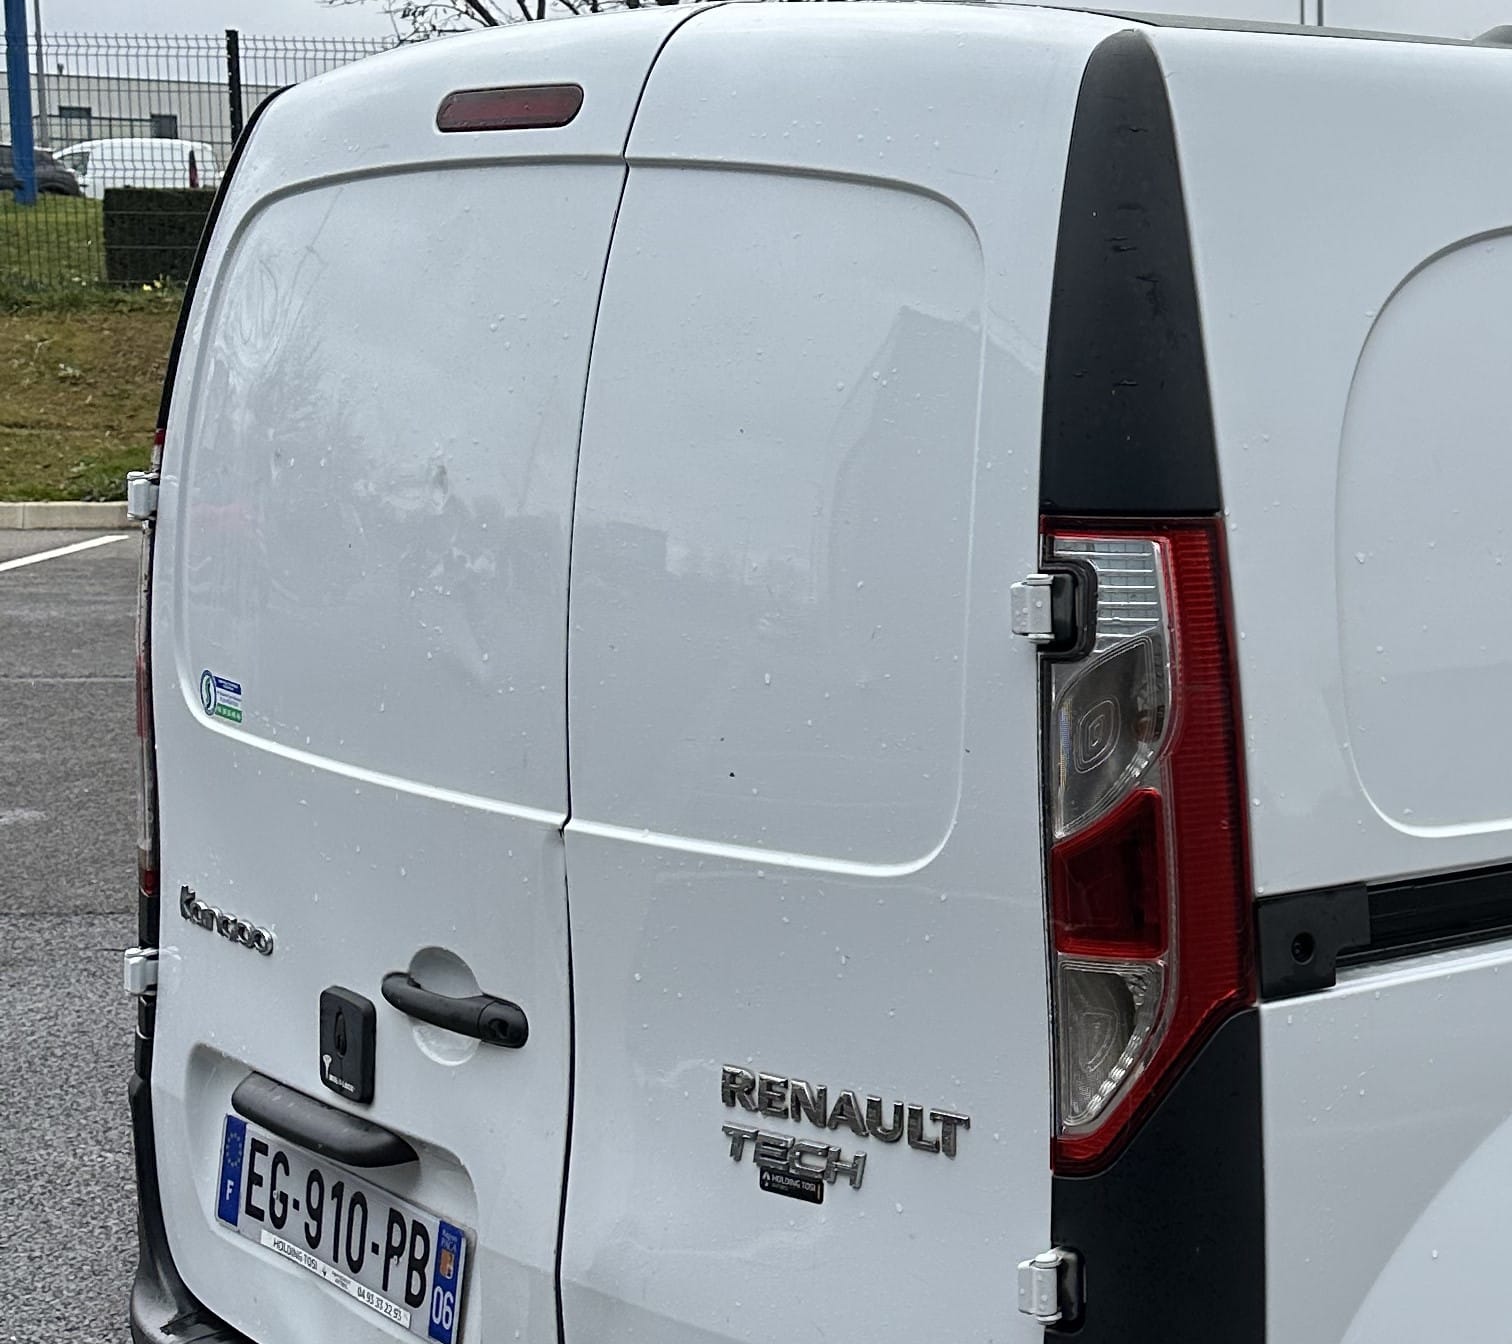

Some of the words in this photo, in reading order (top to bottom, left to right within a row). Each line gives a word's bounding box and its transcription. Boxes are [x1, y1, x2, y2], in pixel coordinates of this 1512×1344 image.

[721, 1064, 971, 1159] RENAULT
[722, 1121, 867, 1189] TECH
[226, 1179, 234, 1200] F
[245, 1138, 430, 1308] EG-910-PB
[273, 1238, 302, 1263] HOLDING
[303, 1254, 318, 1270] TOSI
[432, 1286, 454, 1330] 06
